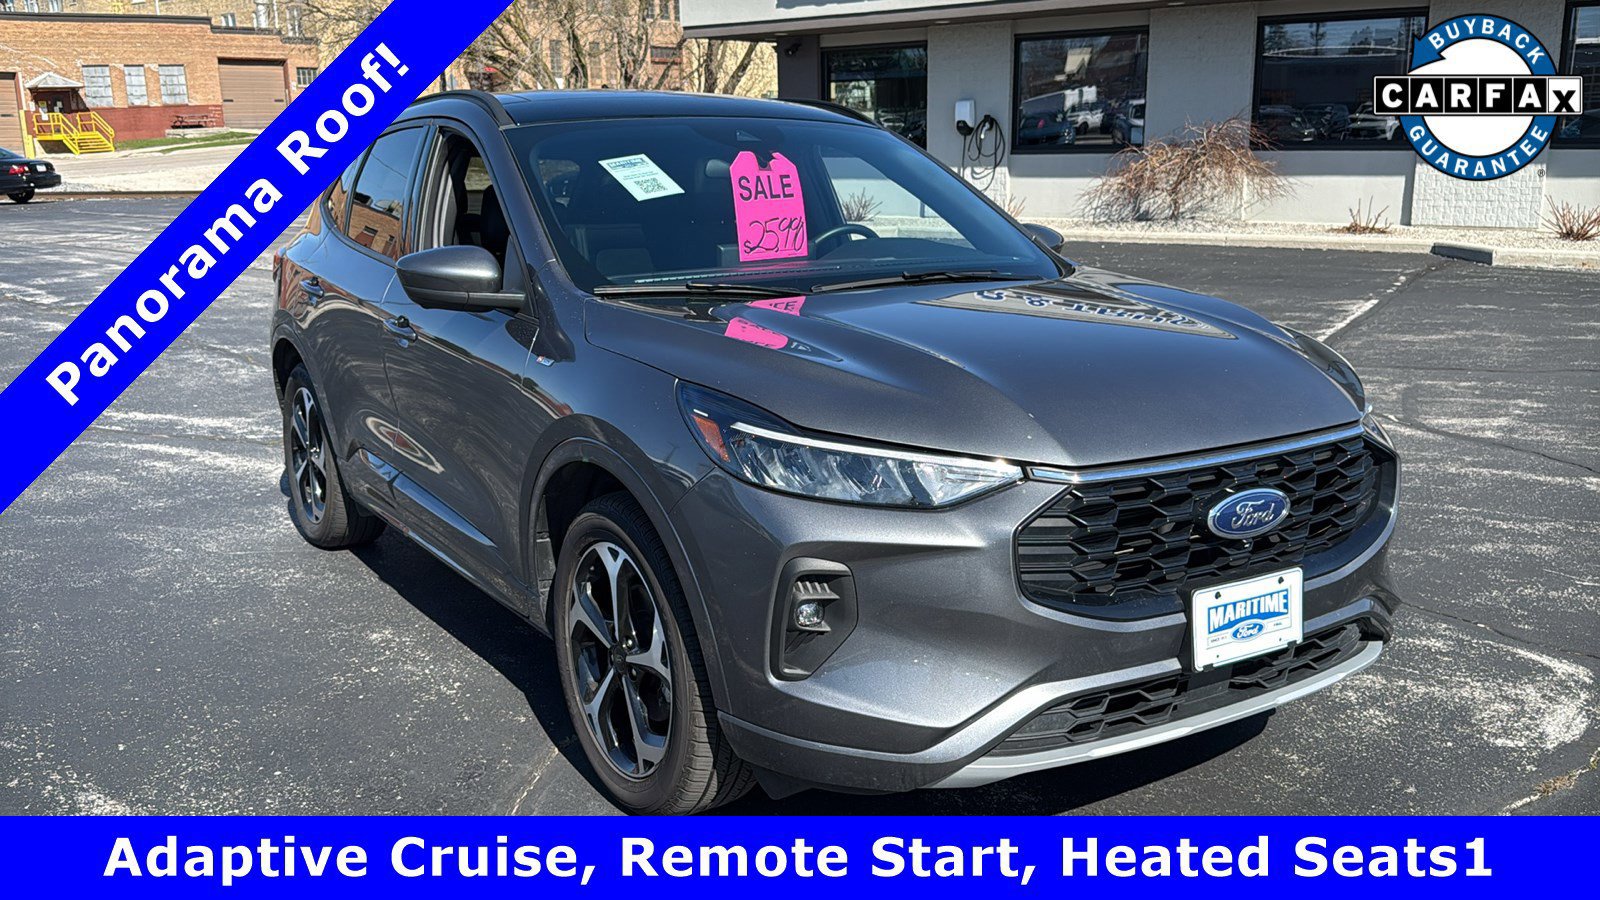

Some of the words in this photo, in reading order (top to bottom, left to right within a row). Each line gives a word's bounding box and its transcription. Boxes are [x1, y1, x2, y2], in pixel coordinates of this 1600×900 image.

[738, 174, 795, 202] SALE
[1231, 499, 1275, 530] Ford
[1209, 591, 1288, 632] MARITIME
[1236, 623, 1260, 638] Ford
